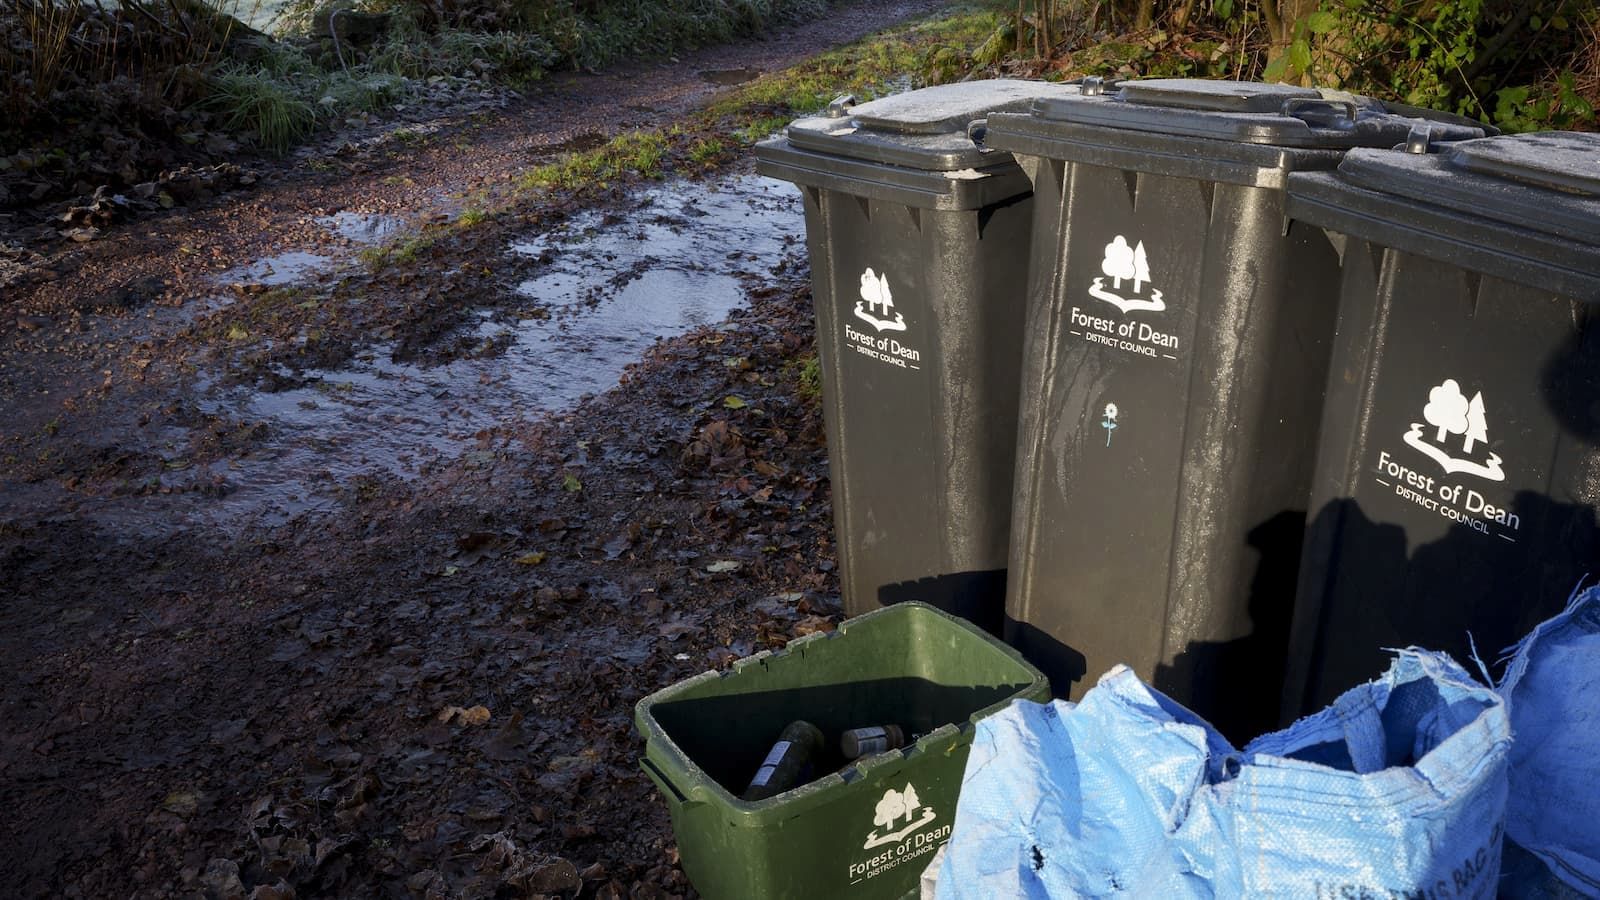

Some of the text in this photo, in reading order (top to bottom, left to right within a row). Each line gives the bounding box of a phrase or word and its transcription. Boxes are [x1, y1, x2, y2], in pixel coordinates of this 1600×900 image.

[845, 323, 920, 361] Forest of Dean
[1071, 306, 1179, 349] Forest of Dean
[1085, 331, 1158, 358] DISTRICT COUNCIL
[856, 345, 907, 368] DISTRICT COUNCIL
[1378, 451, 1521, 530] Forest of Dean
[1395, 484, 1490, 535] DISTRICT COUNCIL
[849, 824, 951, 879] Forest of Dean
[866, 843, 935, 879] DISTRICT COUNCIL
